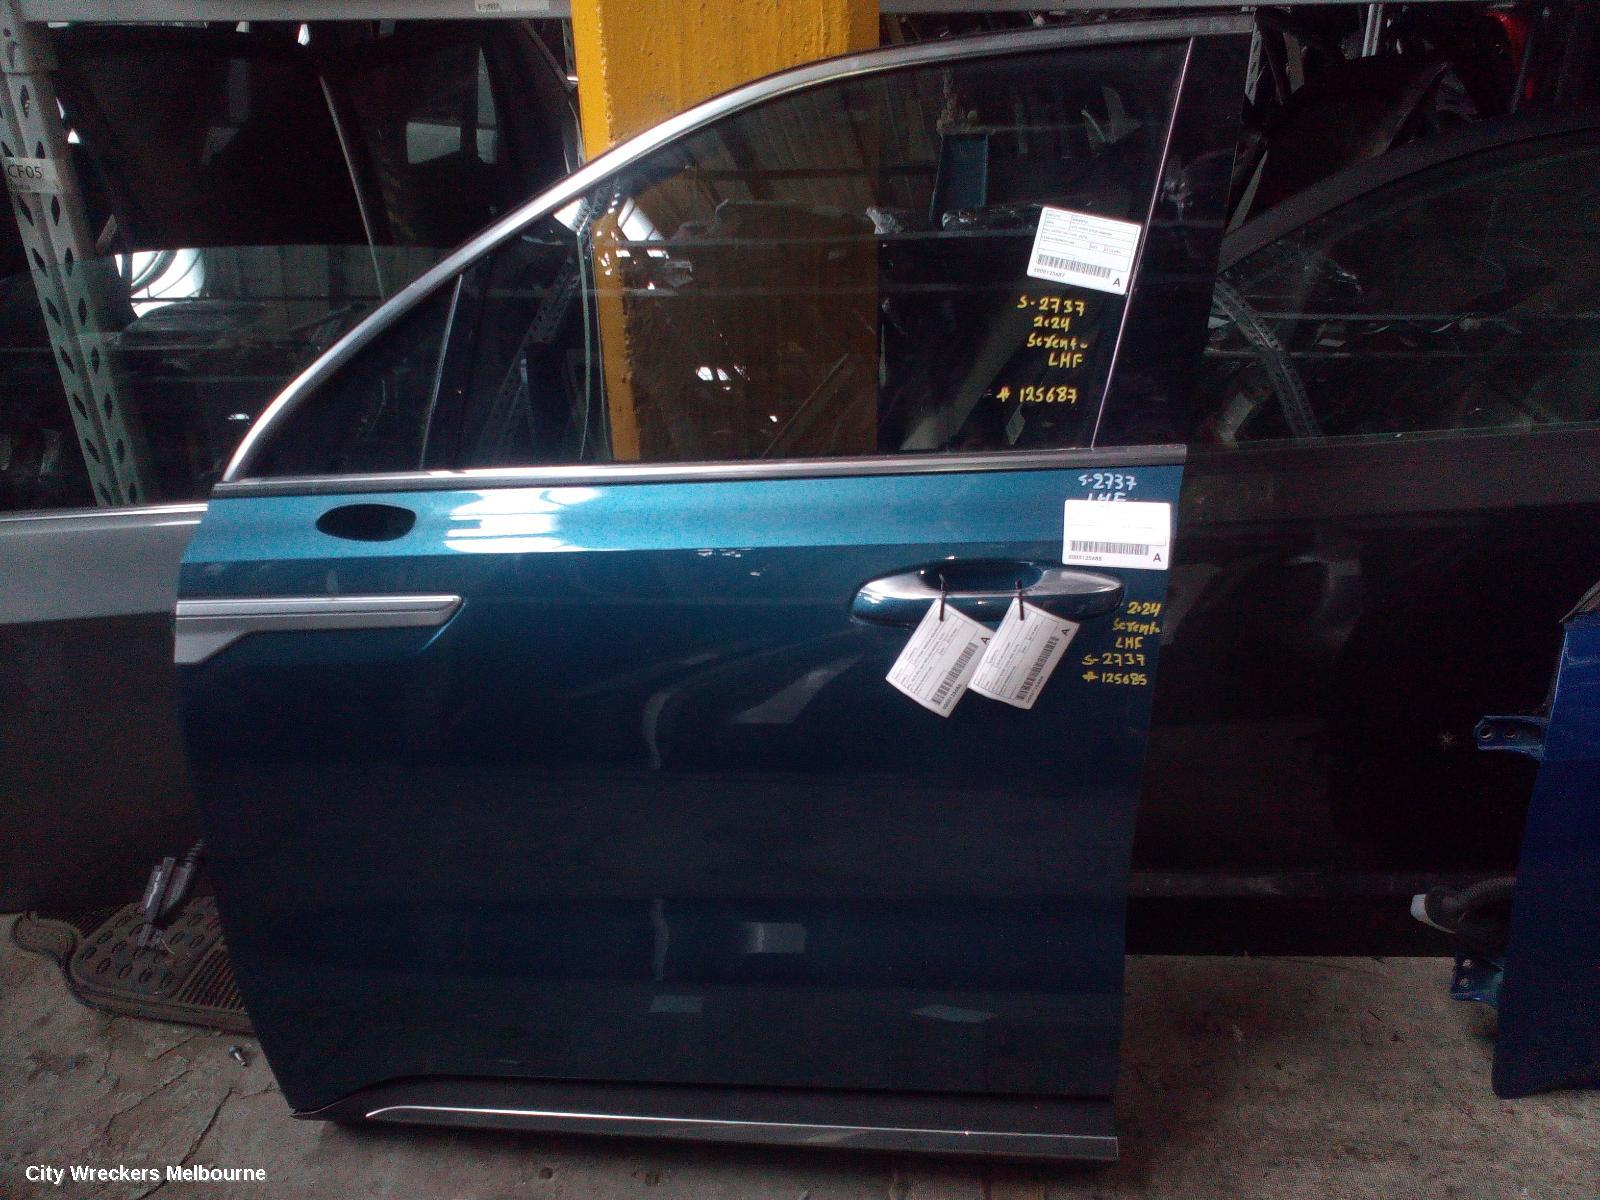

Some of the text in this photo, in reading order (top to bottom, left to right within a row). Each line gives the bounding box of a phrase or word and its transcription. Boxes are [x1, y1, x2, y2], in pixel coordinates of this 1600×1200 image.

[7, 164, 43, 179] CF05
[1112, 277, 1122, 288] A
[1048, 352, 1084, 368] LHF
[1019, 385, 1078, 404] 125687
[1078, 473, 1137, 490] S-2737
[1152, 553, 1162, 562] A
[1061, 627, 1071, 637] A
[980, 636, 990, 646] A
[1115, 636, 1144, 650] LHF
[1101, 671, 1148, 686] 125685
